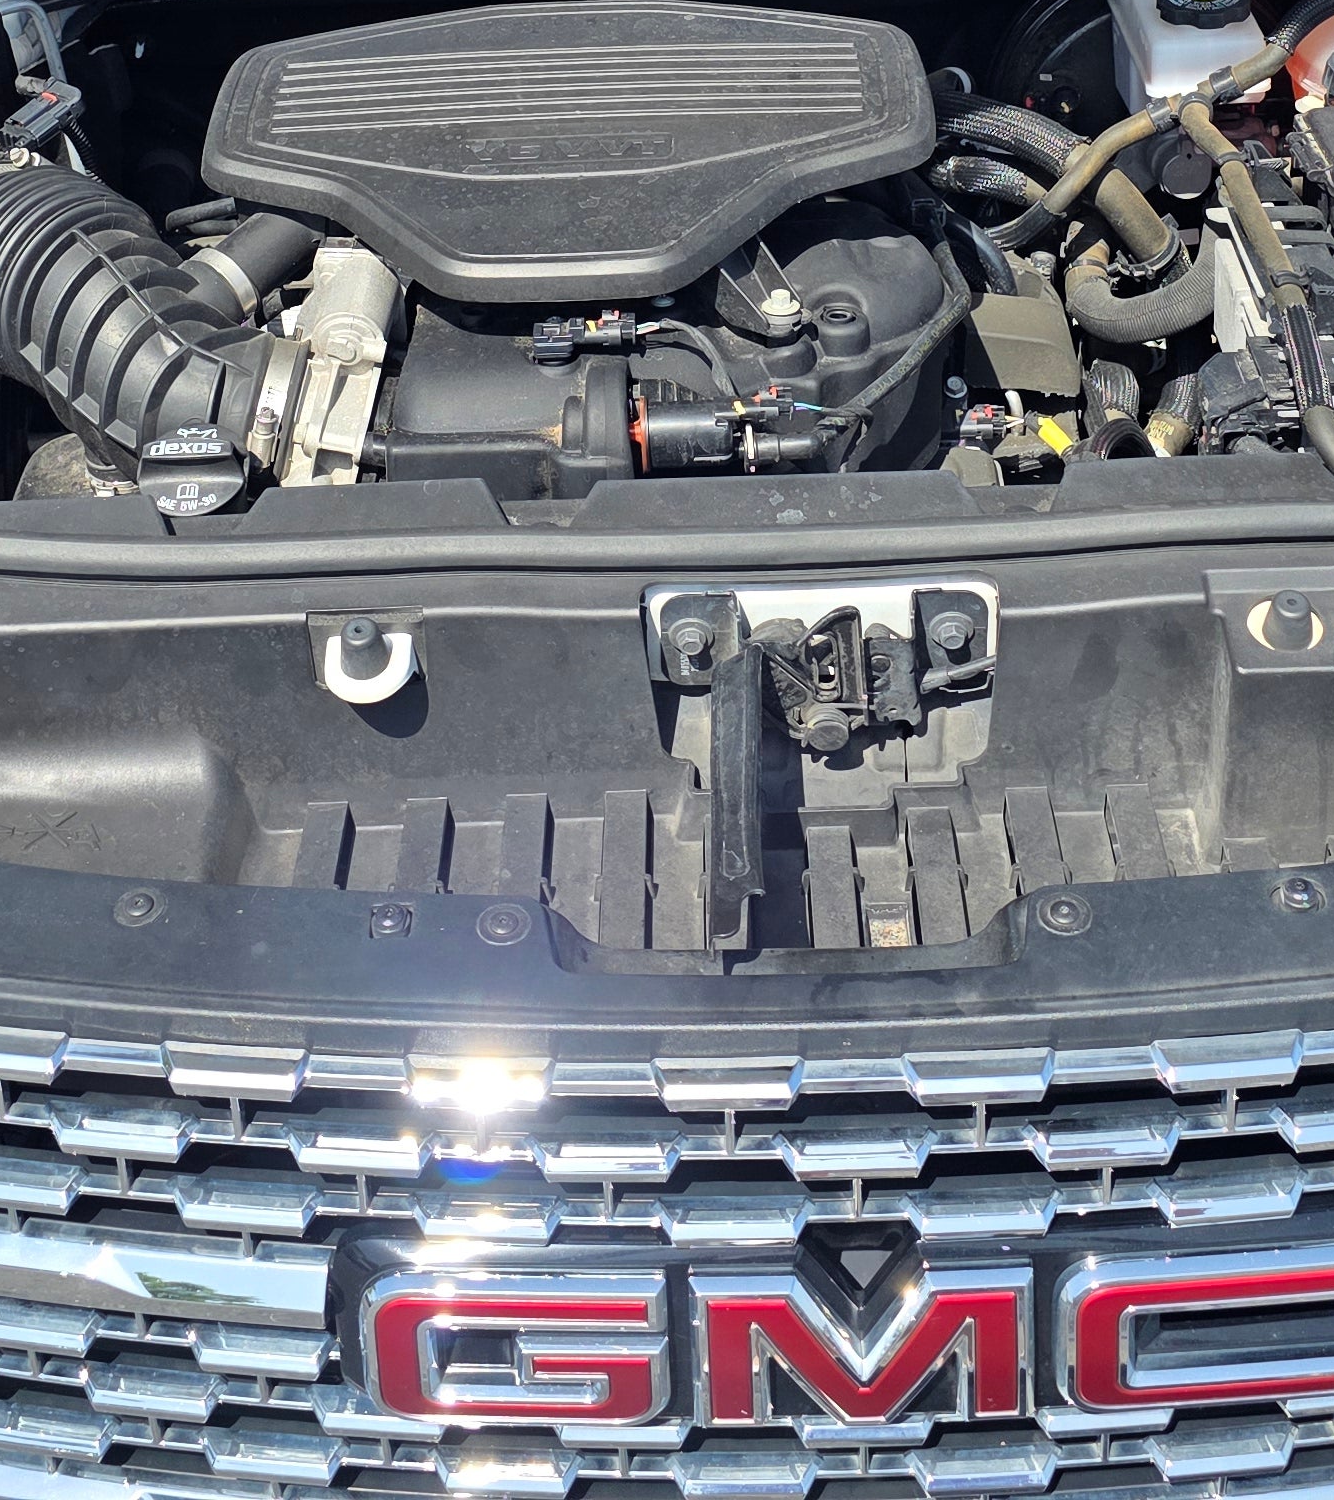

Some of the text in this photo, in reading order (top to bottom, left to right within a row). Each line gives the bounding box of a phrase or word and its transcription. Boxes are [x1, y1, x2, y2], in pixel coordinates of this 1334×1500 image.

[150, 441, 224, 456] dexos
[157, 493, 217, 512] SAE 5W-30
